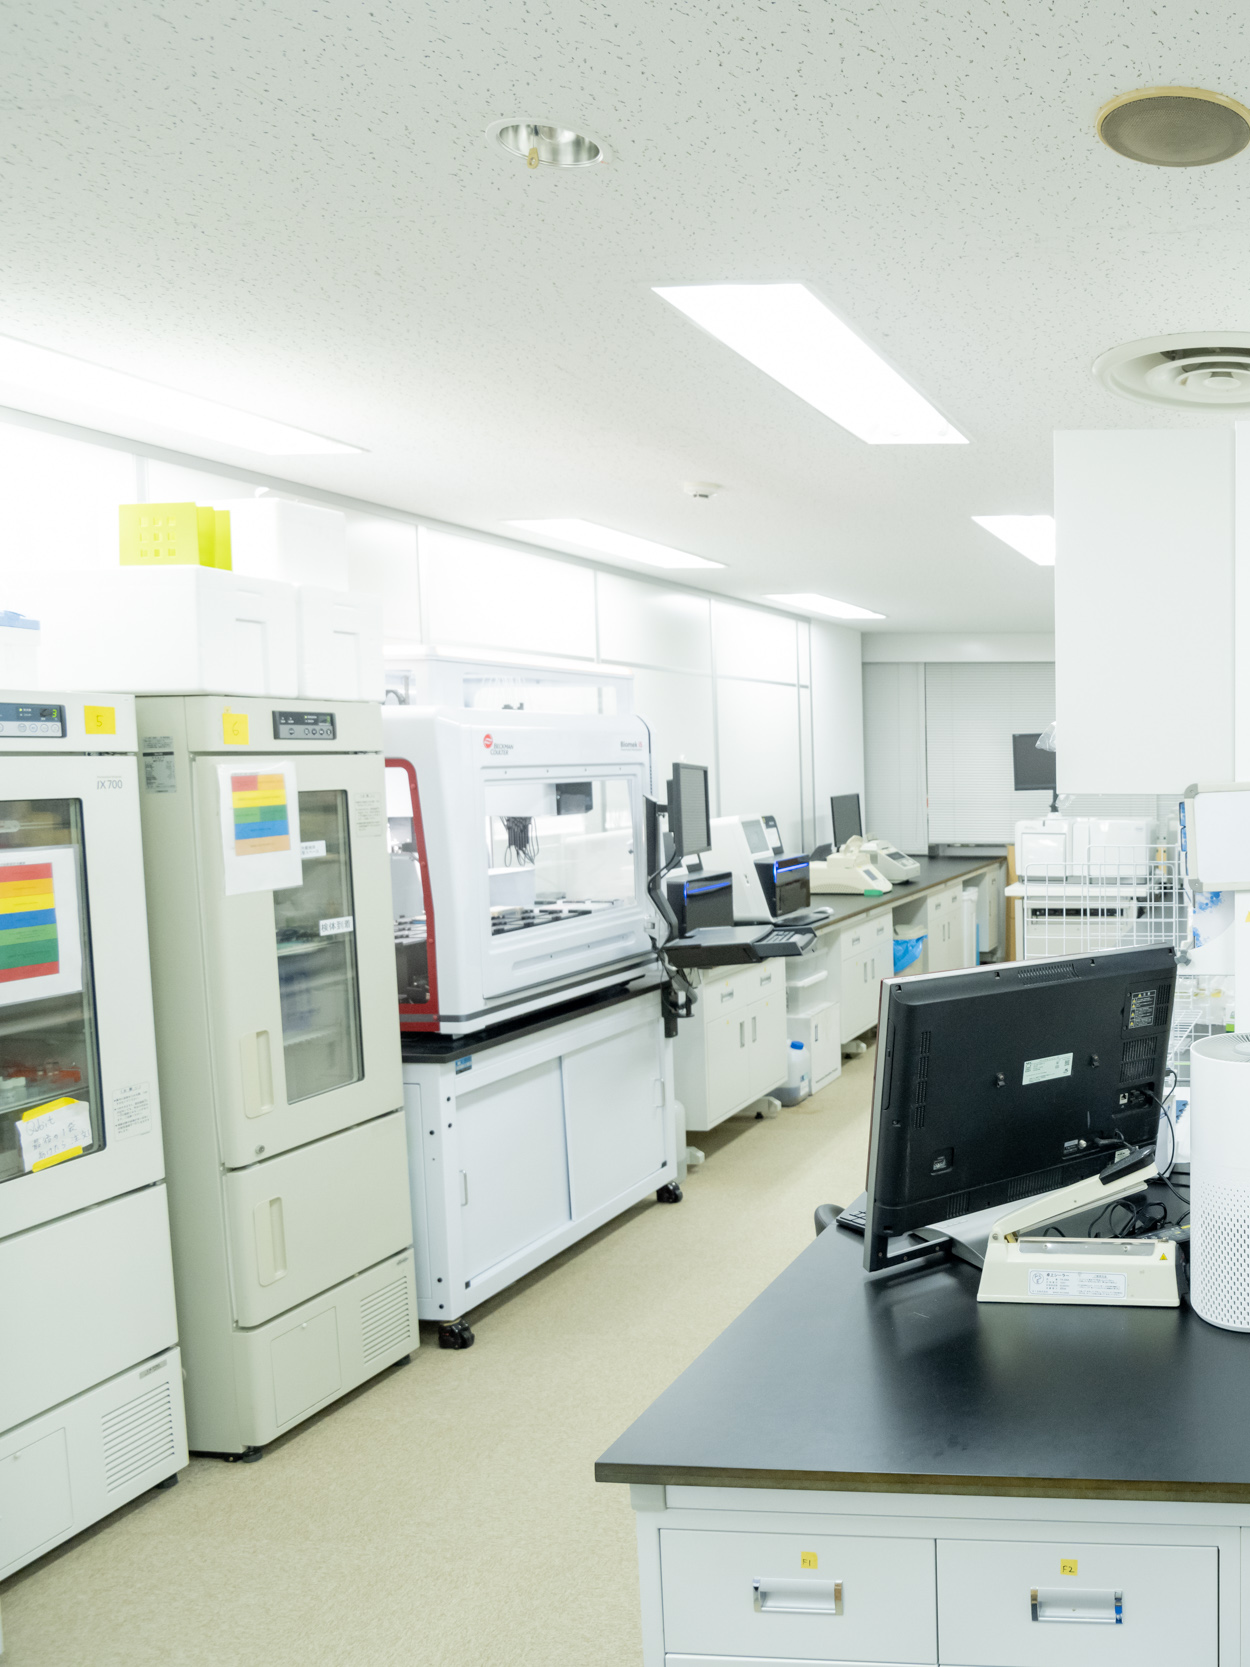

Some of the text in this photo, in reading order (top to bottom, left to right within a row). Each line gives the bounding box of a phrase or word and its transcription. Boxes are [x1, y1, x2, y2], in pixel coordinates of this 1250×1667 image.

[96, 714, 104, 727] 5
[231, 721, 240, 736] 6
[321, 920, 351, 932] 検体到着
[802, 1558, 811, 1567] F1
[1062, 1565, 1075, 1573] F2
